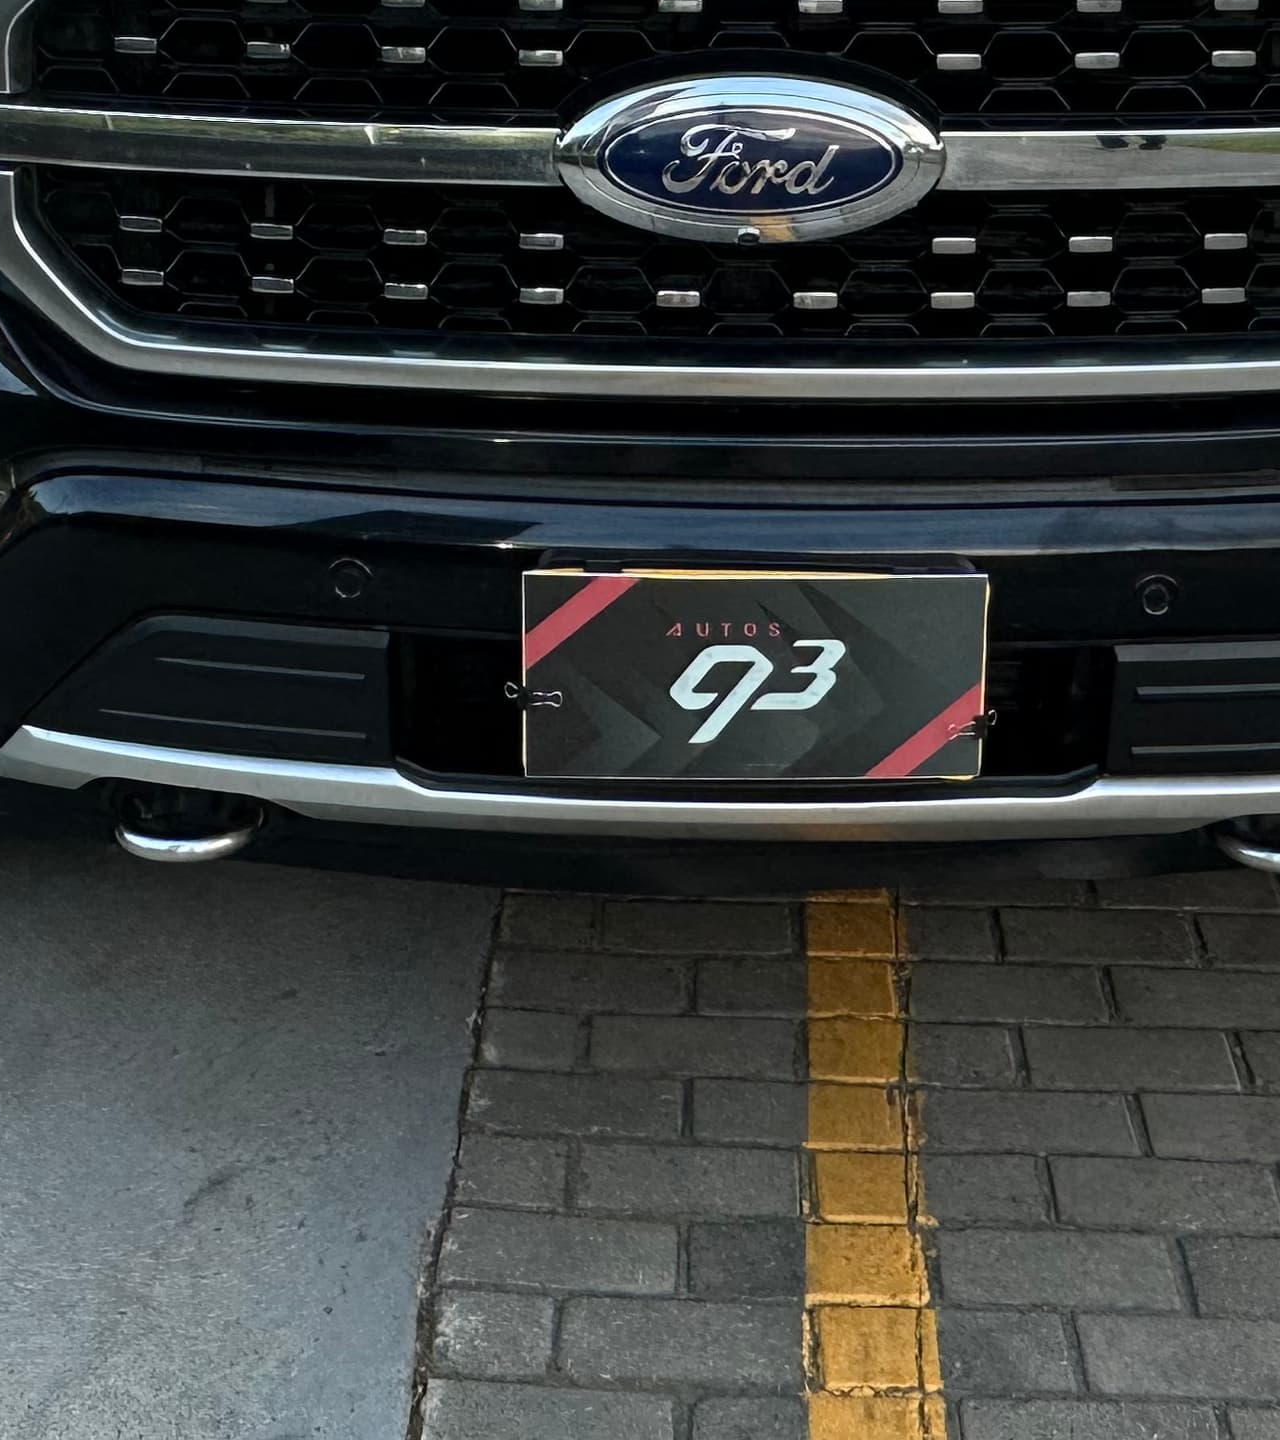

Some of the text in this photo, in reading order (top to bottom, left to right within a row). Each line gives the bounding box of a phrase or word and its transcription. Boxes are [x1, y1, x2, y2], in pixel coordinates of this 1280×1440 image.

[661, 123, 840, 194] Ford
[665, 622, 782, 638] AUTOS
[669, 639, 847, 744] 93
